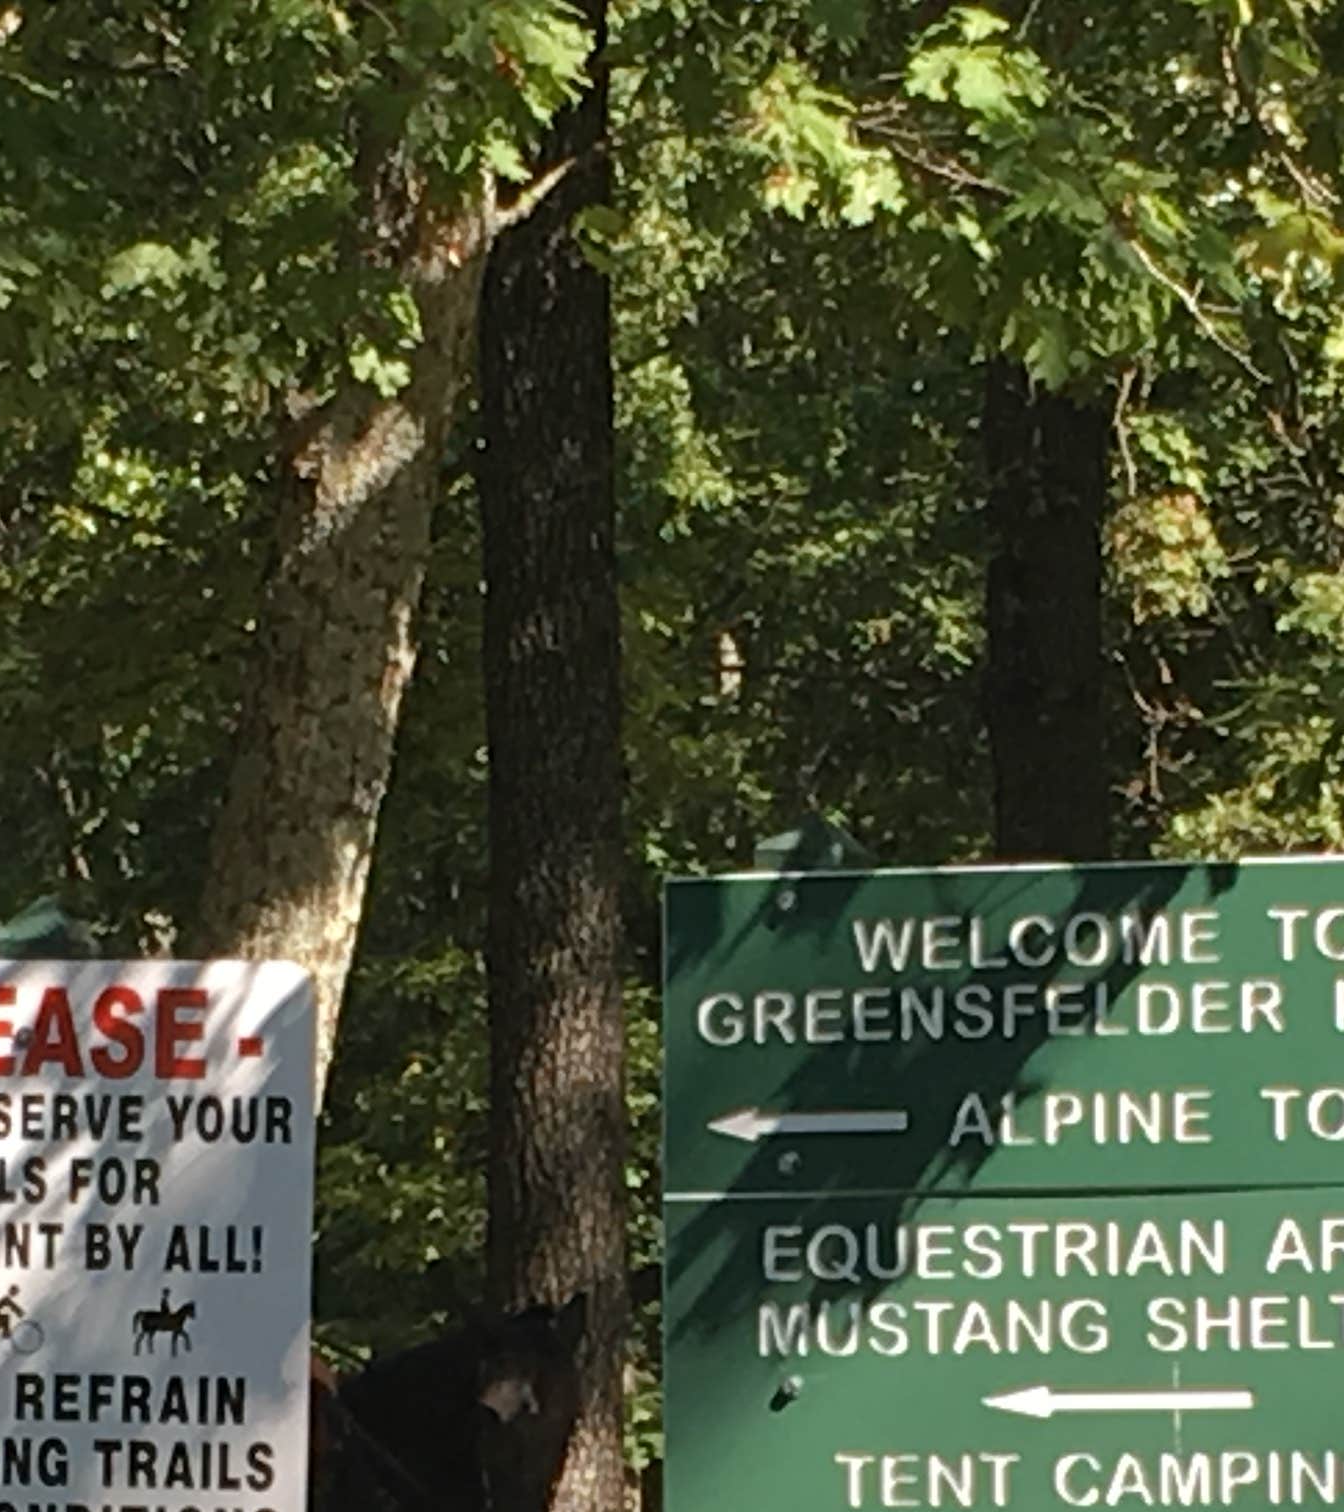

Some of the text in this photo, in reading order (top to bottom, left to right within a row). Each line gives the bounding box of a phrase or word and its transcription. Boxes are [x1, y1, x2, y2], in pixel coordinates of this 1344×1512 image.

[853, 911, 1223, 974] WELCOME
[697, 982, 1285, 1046] GREENSFELDER
[167, 1096, 294, 1145] YOUR
[948, 1091, 1213, 1148] ALPINE
[68, 1158, 162, 1206] FOR
[84, 1224, 145, 1271] BY
[163, 1225, 264, 1274] ALL!
[763, 1219, 1226, 1283] EQUESTRIAN
[758, 1299, 1109, 1358] MUSTANG
[15, 1374, 246, 1425] REFRAIN
[93, 1440, 276, 1492] TRAILS
[833, 1453, 1020, 1508] TENT
